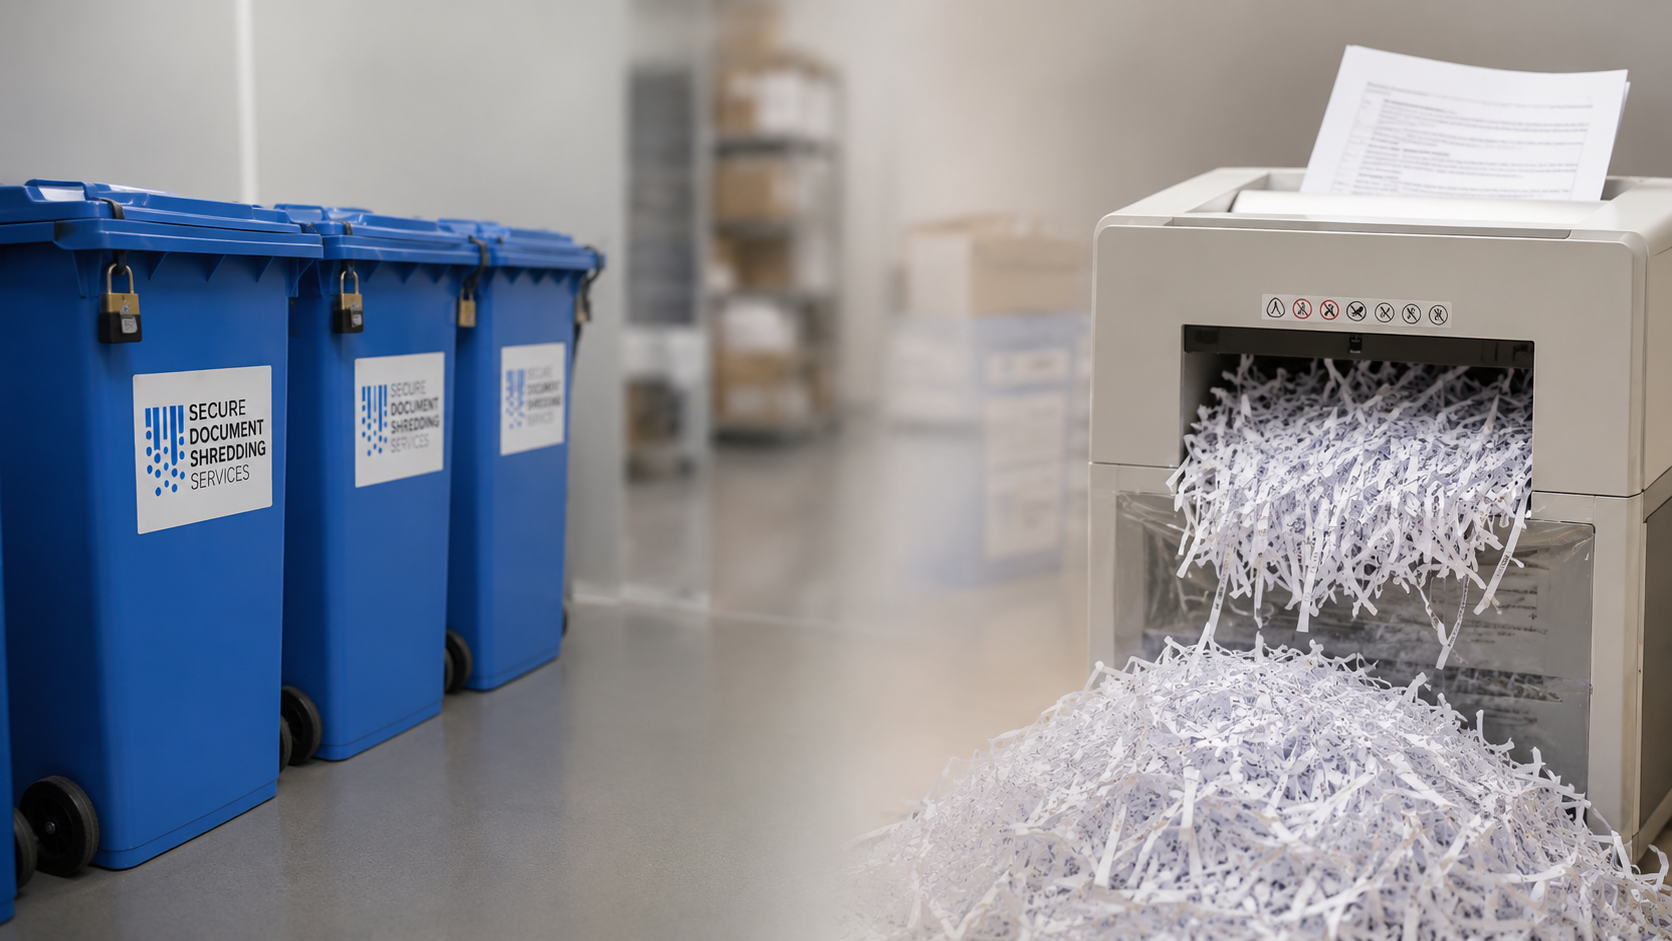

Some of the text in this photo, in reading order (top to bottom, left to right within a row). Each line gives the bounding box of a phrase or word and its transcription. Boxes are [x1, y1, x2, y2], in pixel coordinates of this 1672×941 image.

[390, 380, 426, 398] SECURE
[189, 399, 246, 421] SECURE
[390, 396, 439, 416] DOCUMENT
[189, 419, 264, 445] DOCUMENT
[390, 414, 439, 435] SHREDDING
[190, 440, 266, 467] SHREDDING
[390, 433, 430, 454] SERVICES
[190, 464, 250, 491] SERVICES
